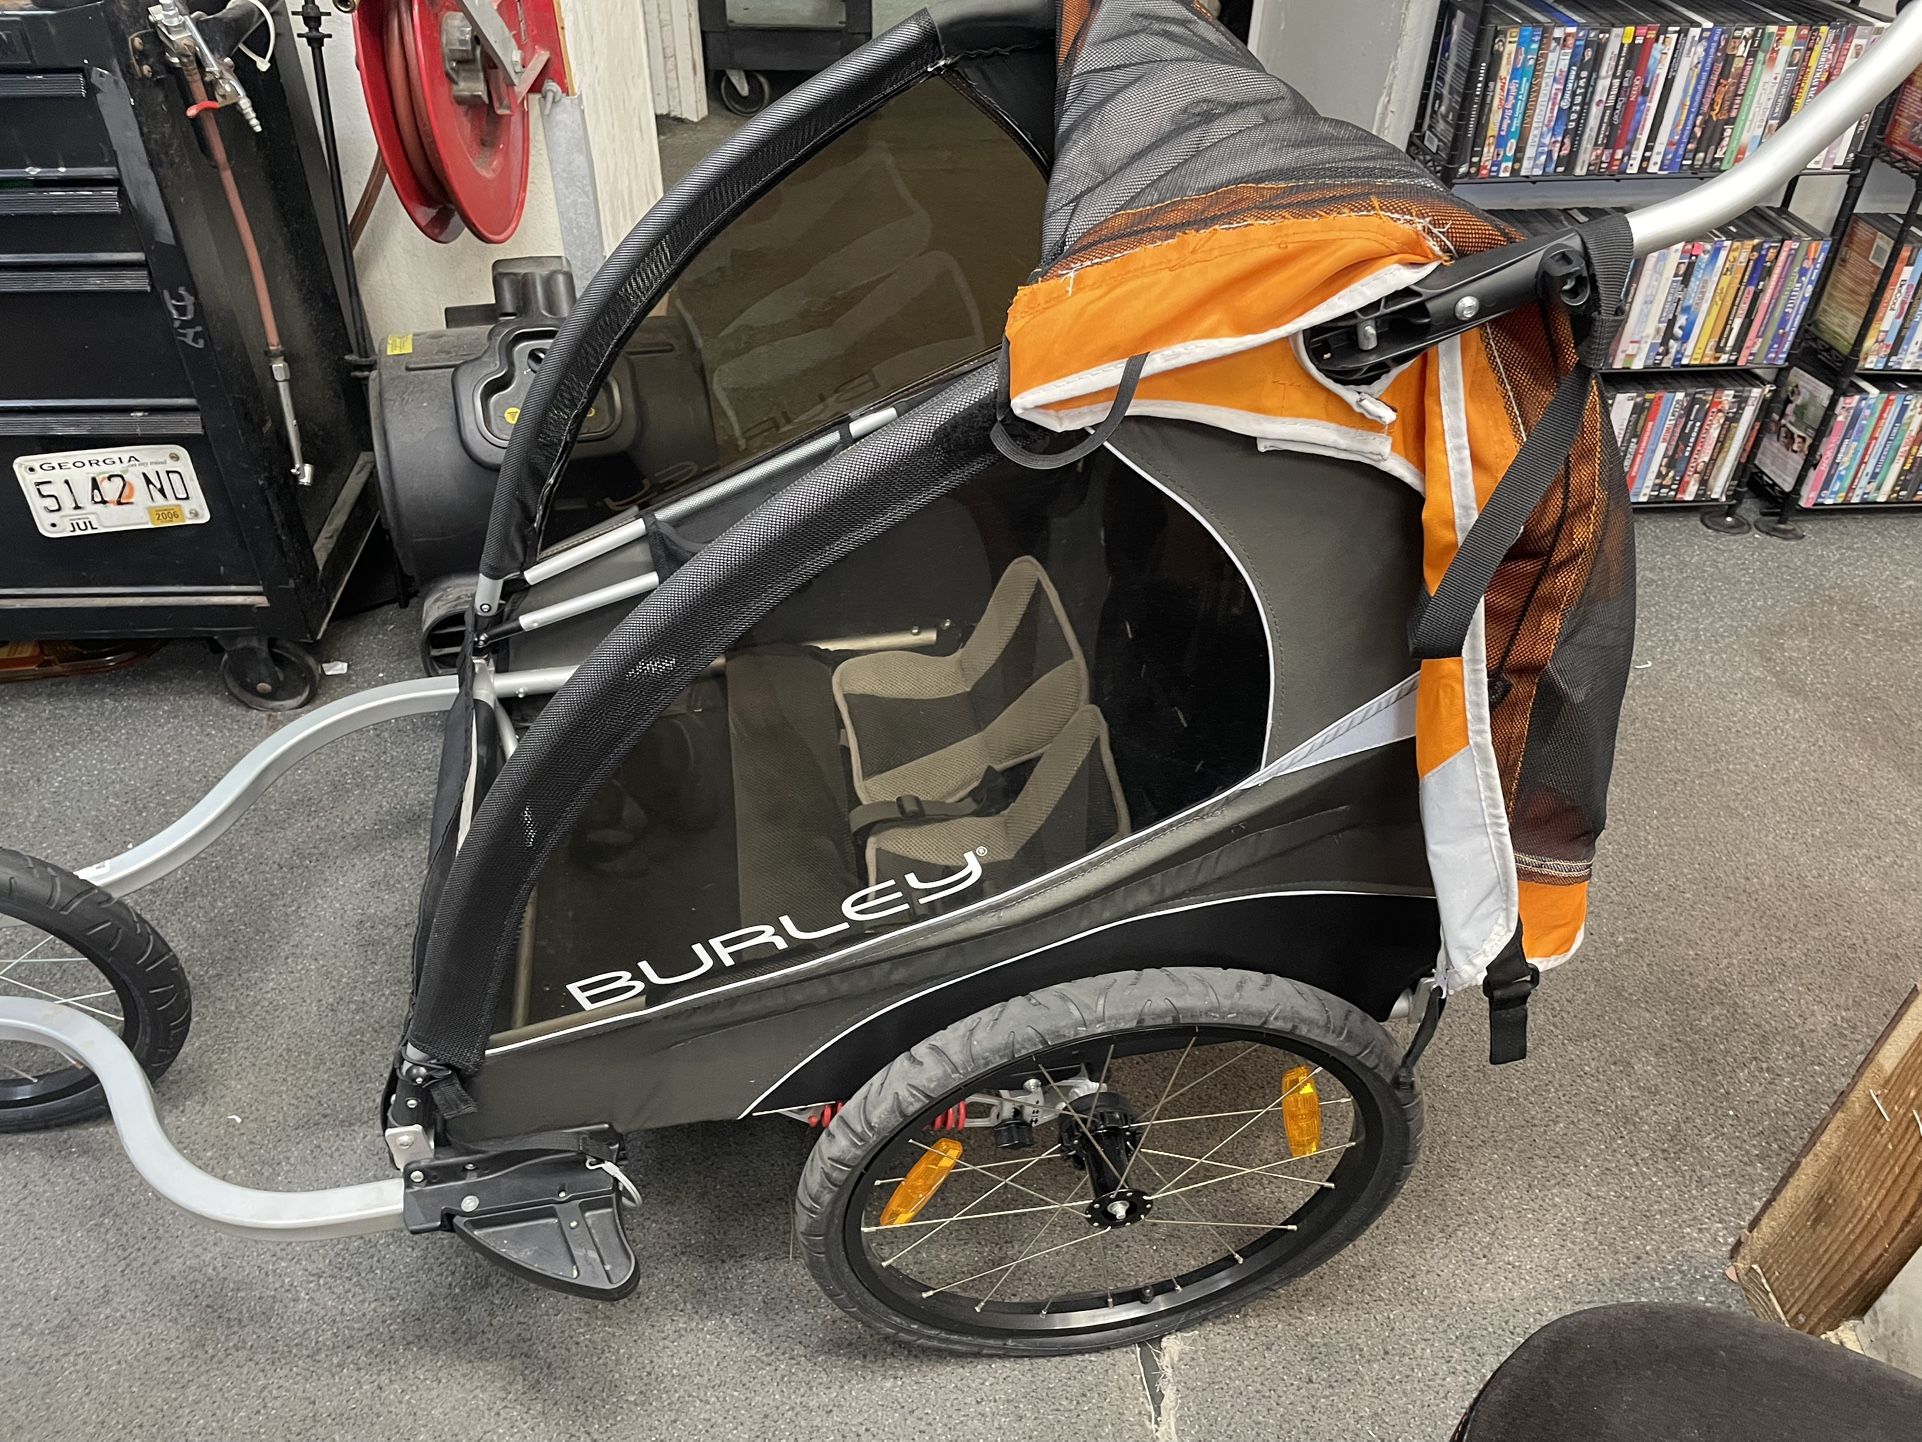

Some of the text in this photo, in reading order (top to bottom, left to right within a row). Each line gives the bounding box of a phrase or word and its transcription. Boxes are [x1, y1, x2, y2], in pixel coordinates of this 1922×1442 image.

[1713, 28, 1722, 41] the
[1534, 50, 1549, 76] LAST
[1703, 43, 1718, 70] perfect
[1811, 48, 1830, 86] CHRISTMAS
[1629, 76, 1642, 102] QUEEN
[1690, 72, 1707, 112] pregnancy
[1522, 79, 1541, 128] SAMURAI
[1681, 114, 1696, 142] workout
[1889, 424, 1900, 440] FIRST
[40, 455, 140, 471] GEORGIA
[34, 470, 190, 512] 5142 ND
[70, 520, 98, 532] JUL
[156, 511, 179, 520] 2006
